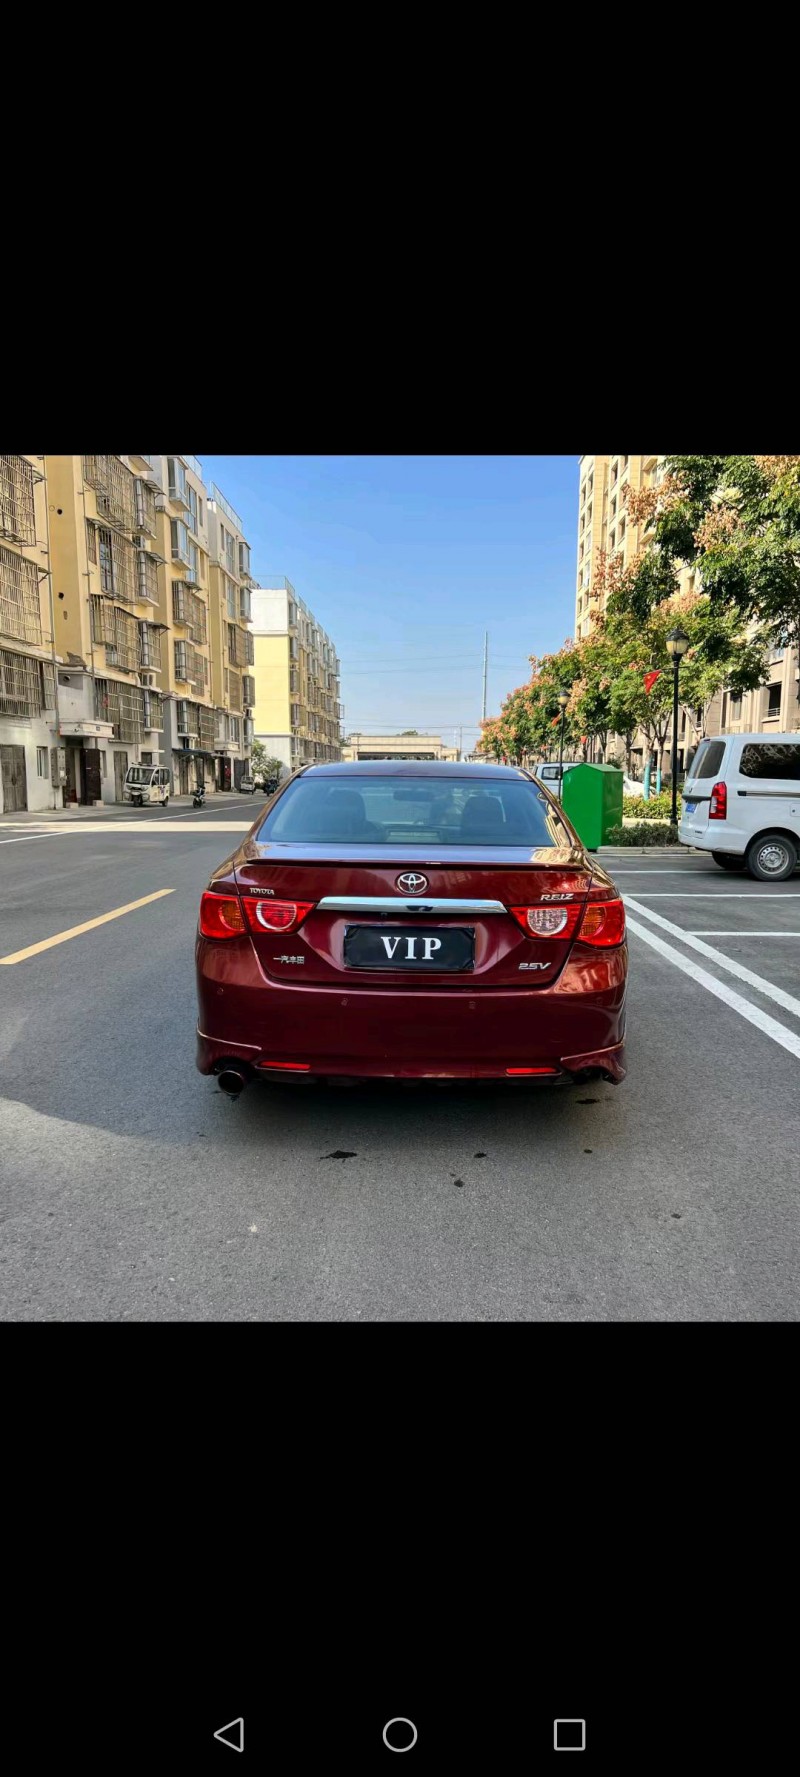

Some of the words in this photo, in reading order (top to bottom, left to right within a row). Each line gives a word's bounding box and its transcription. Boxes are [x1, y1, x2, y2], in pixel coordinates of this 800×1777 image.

[249, 887, 275, 895] TOYOTA
[540, 893, 574, 901] REIZ
[380, 936, 442, 960] VIP
